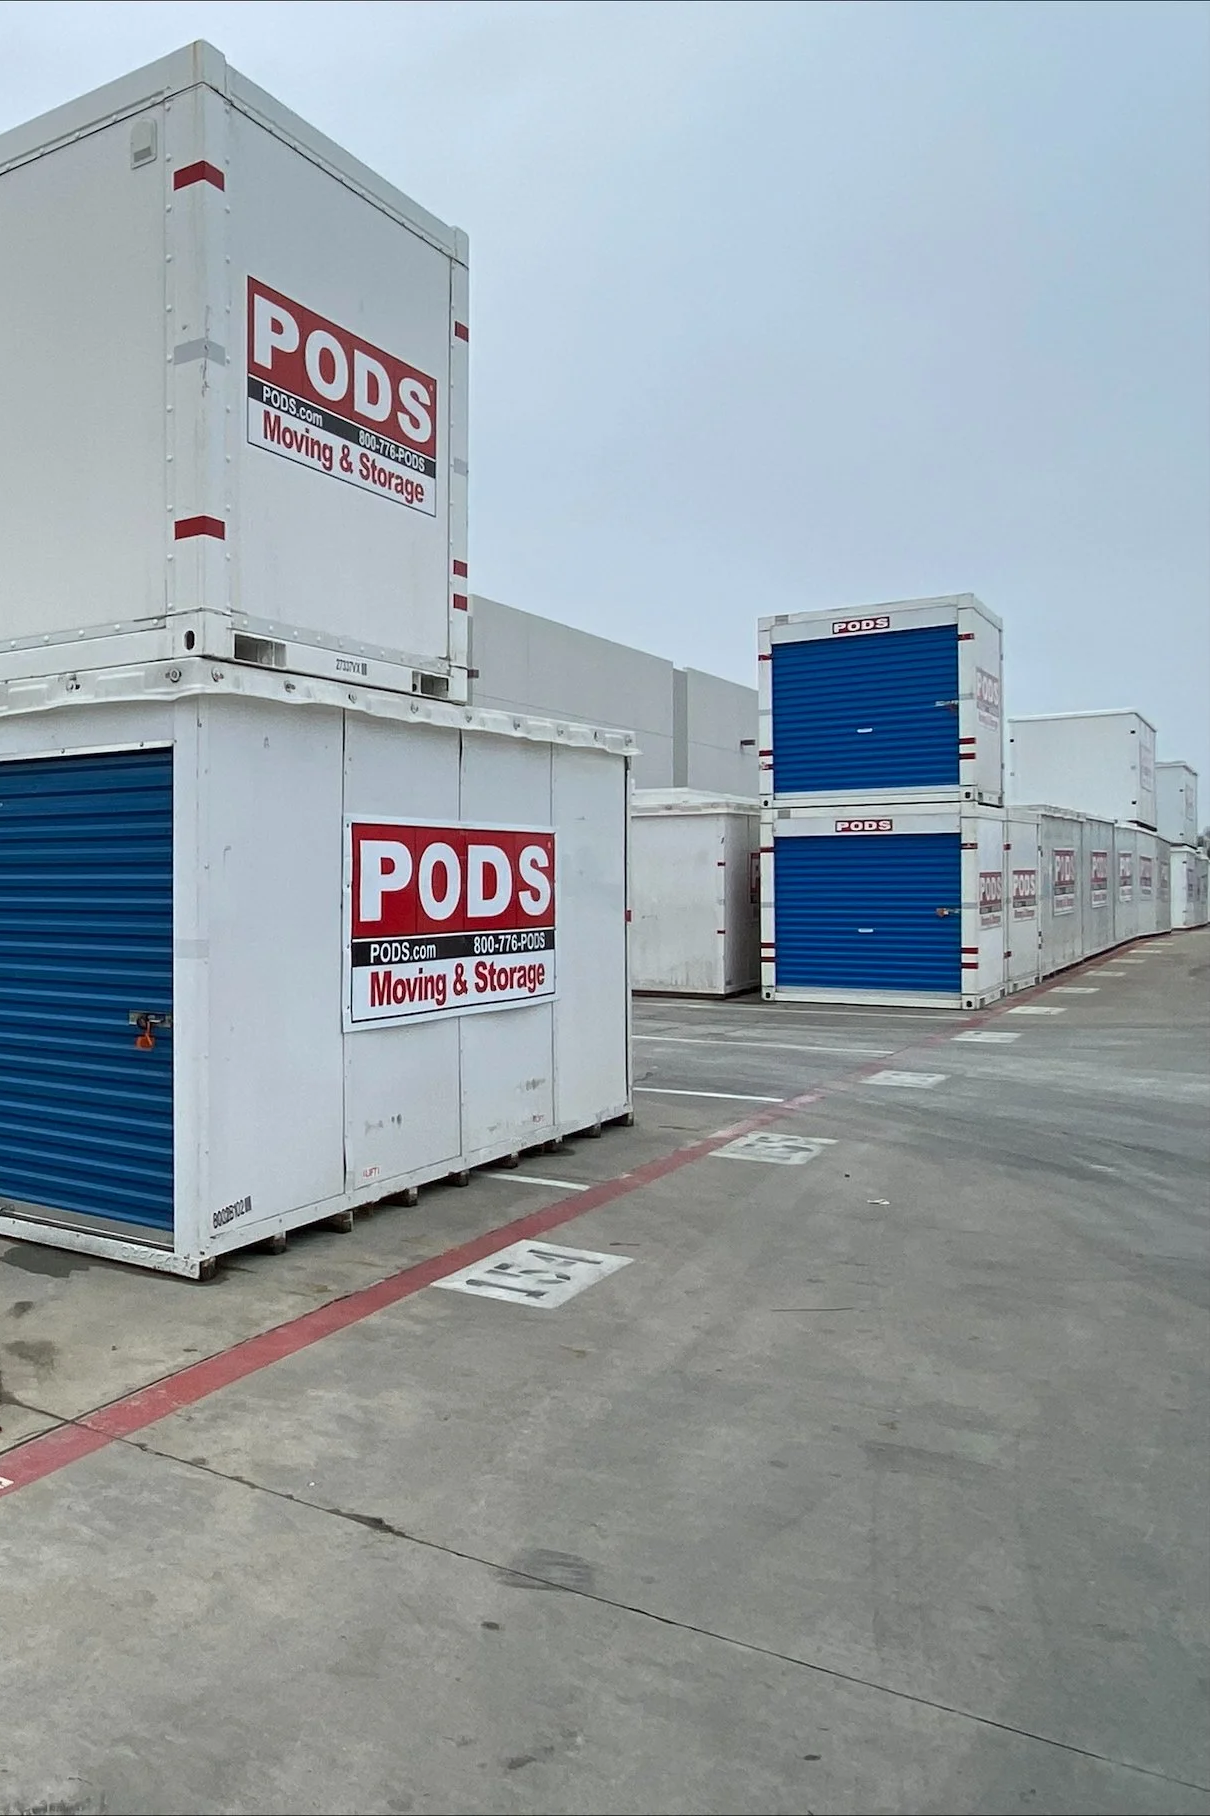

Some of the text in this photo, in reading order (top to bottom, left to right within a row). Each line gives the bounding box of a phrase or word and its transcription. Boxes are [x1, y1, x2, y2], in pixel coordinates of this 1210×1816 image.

[253, 293, 432, 443] PODS
[262, 386, 425, 472] PODS.com 800-776-PODS
[263, 410, 425, 504] Moving & Storage
[833, 618, 889, 633] PODS
[836, 820, 891, 831] PODS
[359, 839, 551, 922] PODS
[1013, 874, 1036, 896] PODS
[369, 932, 546, 964] PODS.com 800-776-PODS
[370, 961, 545, 1007] Moving & Storage
[465, 1249, 604, 1300] 154
